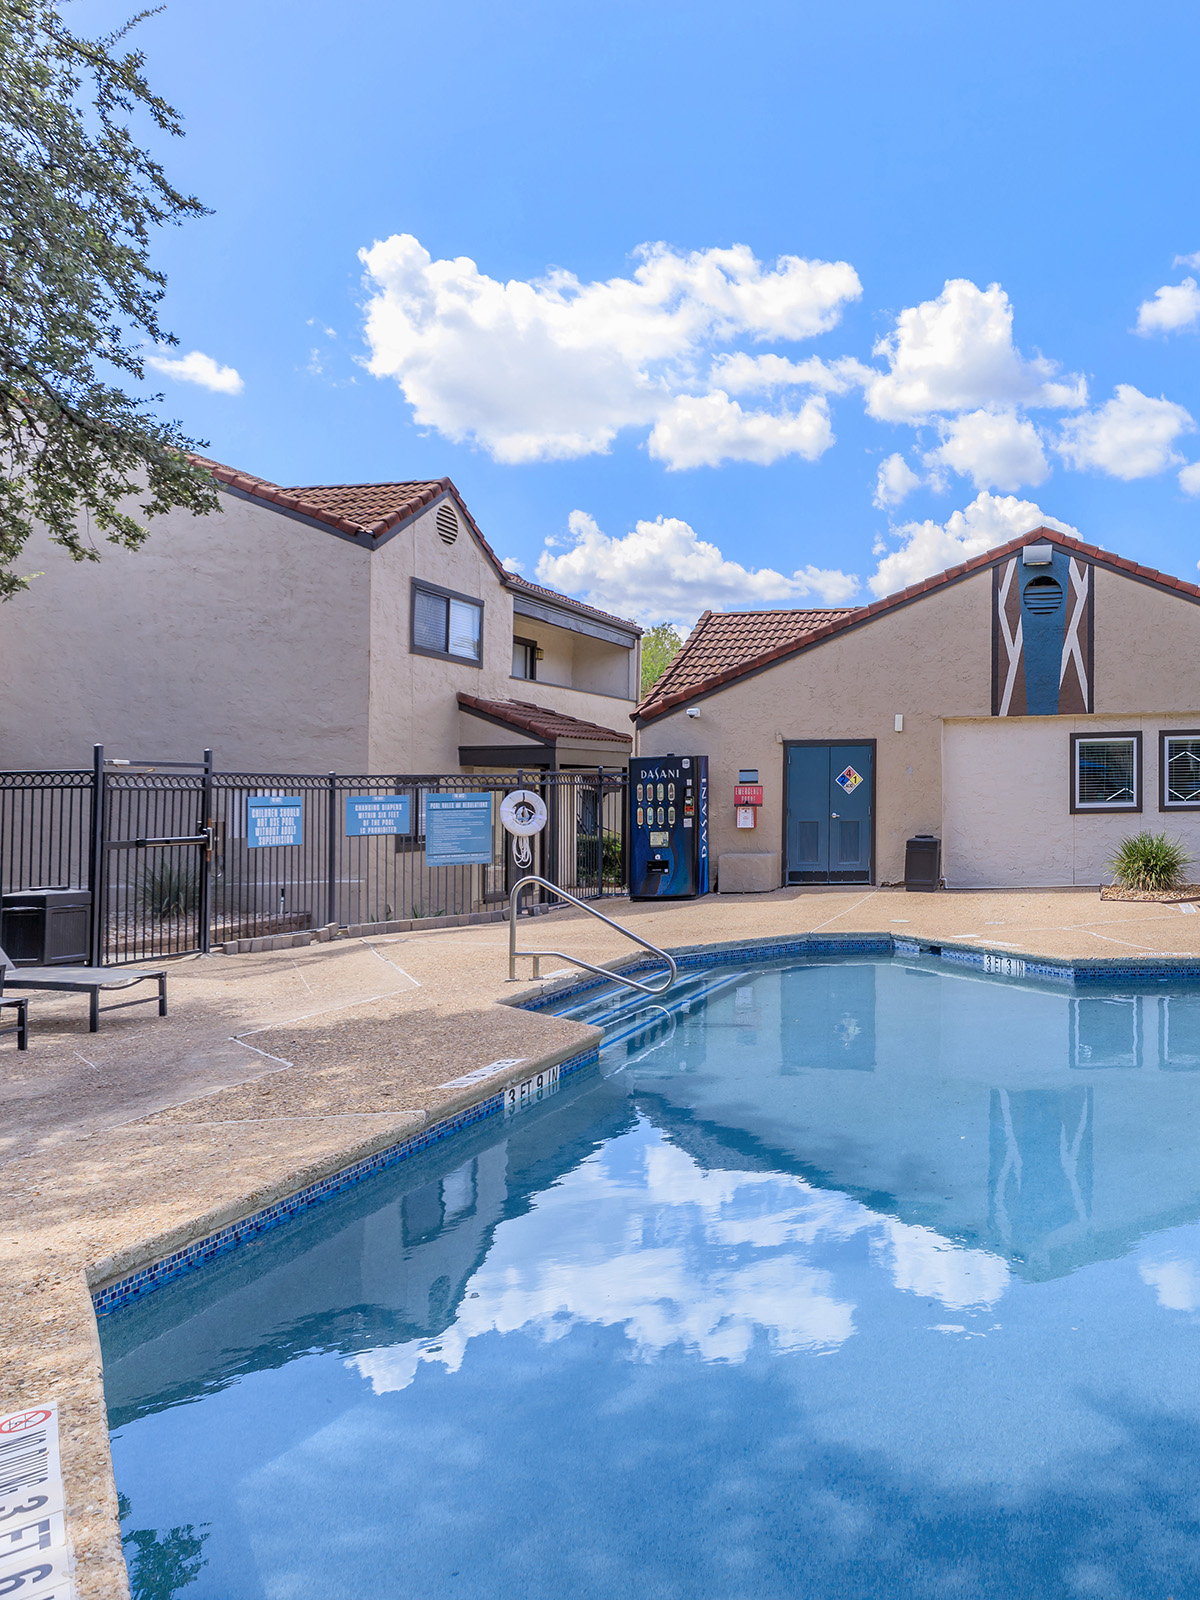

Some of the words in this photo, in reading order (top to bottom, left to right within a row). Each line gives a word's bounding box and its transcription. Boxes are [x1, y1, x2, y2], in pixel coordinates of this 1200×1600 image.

[641, 768, 680, 780] DASANI
[846, 769, 851, 777] 4
[840, 776, 846, 784] 2
[736, 787, 761, 796] EMERGENCY
[381, 803, 402, 811] DIAPERS
[251, 808, 278, 818] CHILDREN
[280, 808, 300, 817] SHOULD
[358, 811, 376, 819] WITHIN
[257, 817, 268, 827] NOT
[270, 817, 280, 826] USE
[282, 816, 295, 826] POOL
[255, 826, 279, 836] WITHOUT
[281, 825, 296, 835] ADULT
[368, 826, 397, 834] PROHIBITED
[258, 835, 293, 845] SUPERVISION
[509, 1089, 515, 1104] 3
[520, 1079, 532, 1099] FT
[537, 1074, 543, 1088] 9
[548, 1066, 558, 1084] IN
[0, 1430, 46, 1456] NO
[0, 1494, 49, 1521] 3
[0, 1518, 51, 1558] FT
[0, 1563, 53, 1596] 6
